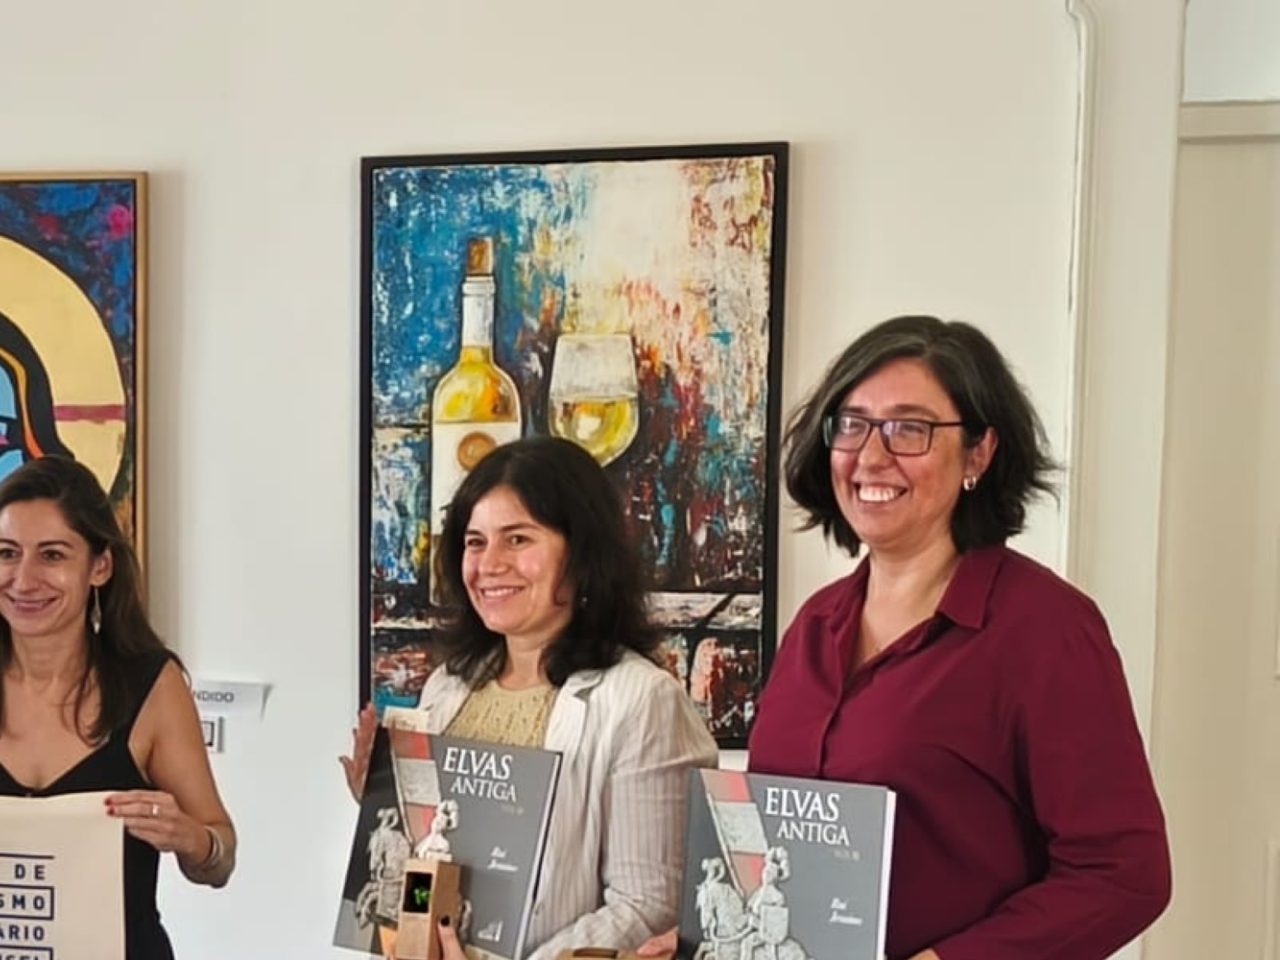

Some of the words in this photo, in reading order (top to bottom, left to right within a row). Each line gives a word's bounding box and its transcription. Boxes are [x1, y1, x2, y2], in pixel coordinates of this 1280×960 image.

[443, 747, 513, 780] ELVAS
[450, 775, 516, 802] ANTIGA
[765, 787, 840, 822] ELVAS
[777, 820, 850, 847] ANTIGA
[14, 863, 46, 880] DE
